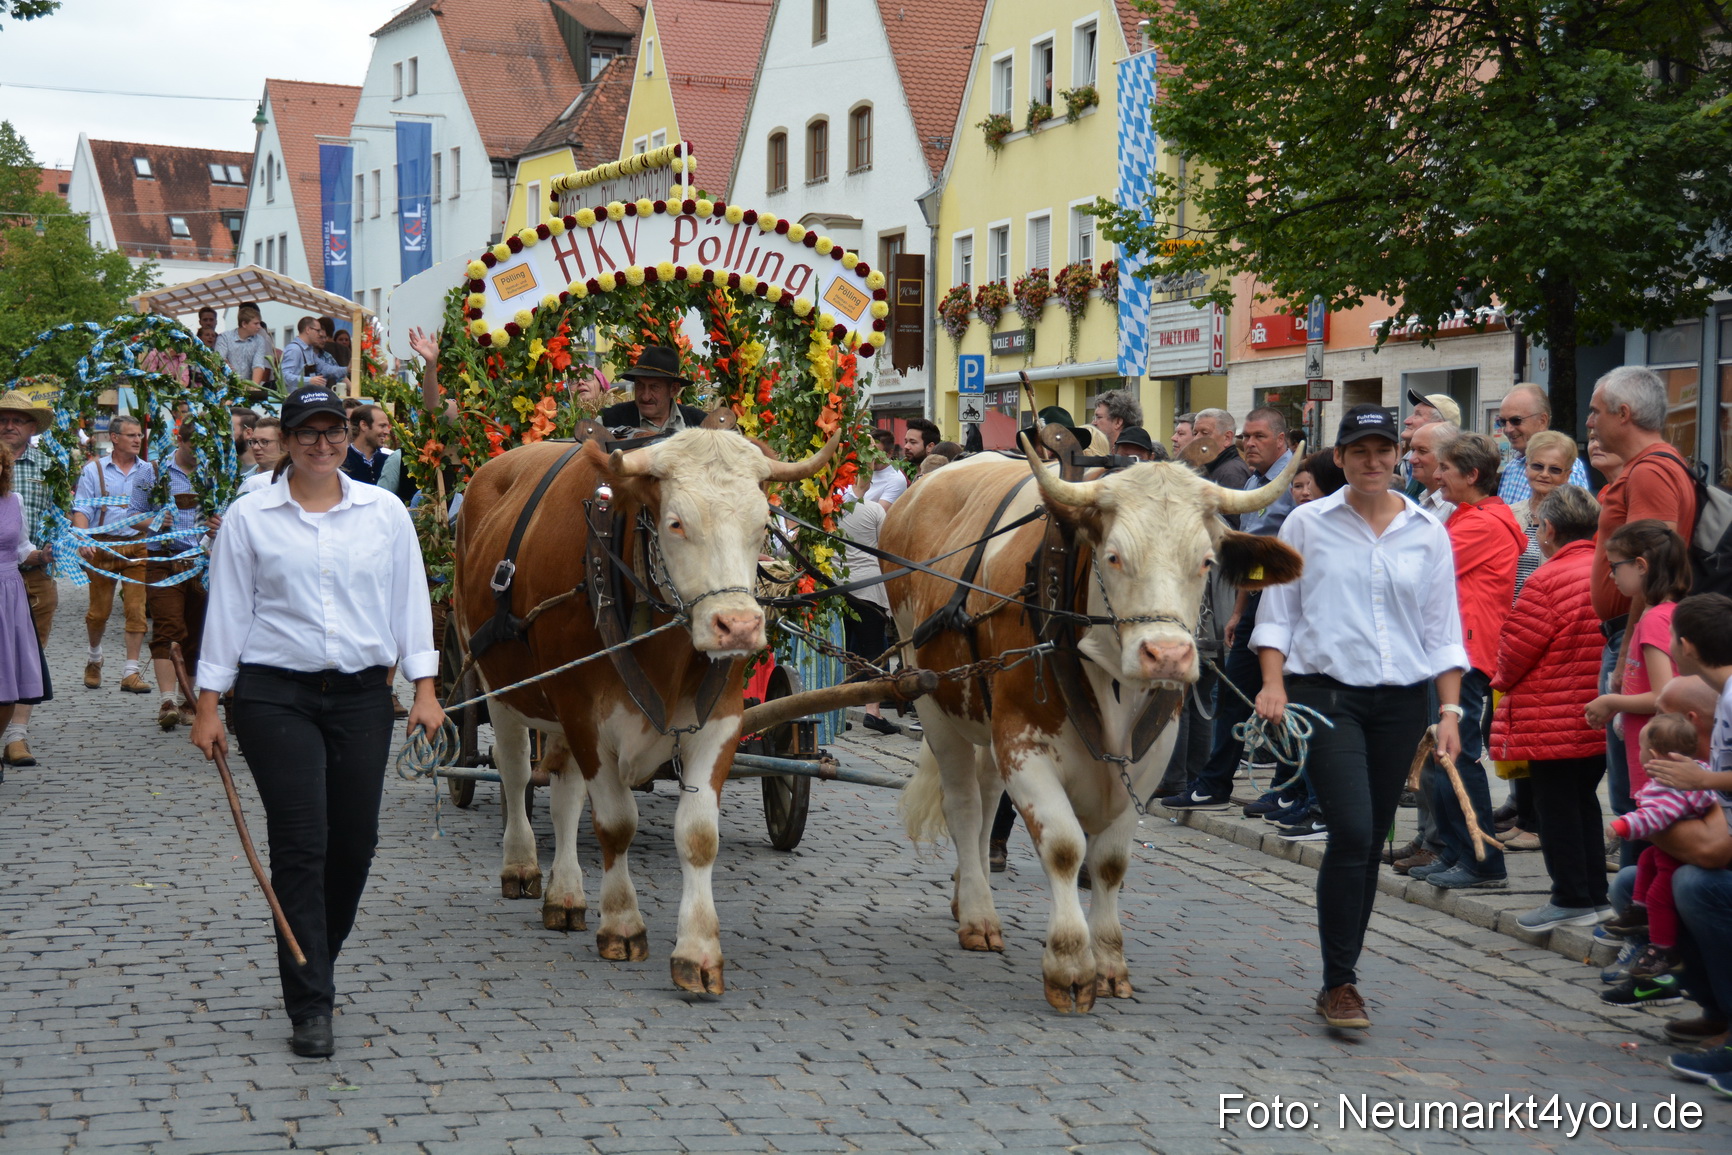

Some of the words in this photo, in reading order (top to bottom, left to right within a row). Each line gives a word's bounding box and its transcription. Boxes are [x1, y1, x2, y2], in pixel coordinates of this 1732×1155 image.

[551, 217, 639, 285] HKV
[670, 215, 813, 295] Pölling
[501, 271, 526, 285] Pölling
[838, 285, 861, 306] Pölling
[992, 336, 1008, 350] WOLLE
[1160, 330, 1182, 346] RIALTO
[1184, 328, 1200, 344] KINO
[1214, 301, 1223, 368] KINO
[964, 360, 979, 388] P
[985, 392, 997, 405] OLLE
